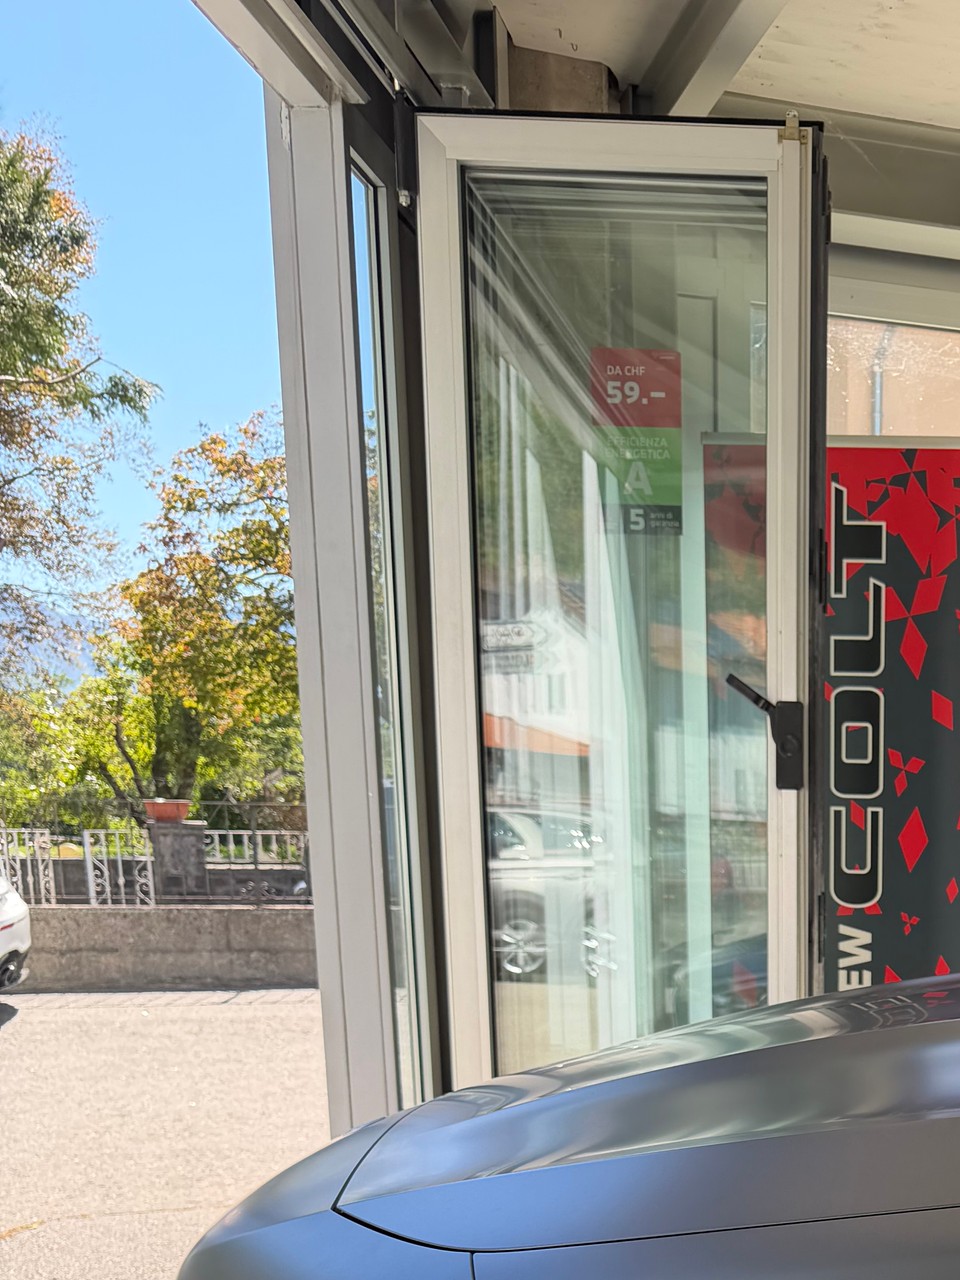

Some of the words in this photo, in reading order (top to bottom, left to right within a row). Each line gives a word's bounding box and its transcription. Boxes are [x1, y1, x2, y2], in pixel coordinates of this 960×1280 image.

[606, 365, 623, 376] DA
[624, 365, 646, 376] CHF
[622, 460, 654, 496] A
[629, 508, 646, 531] 5
[830, 481, 887, 909] COLT
[837, 923, 873, 993] EW
